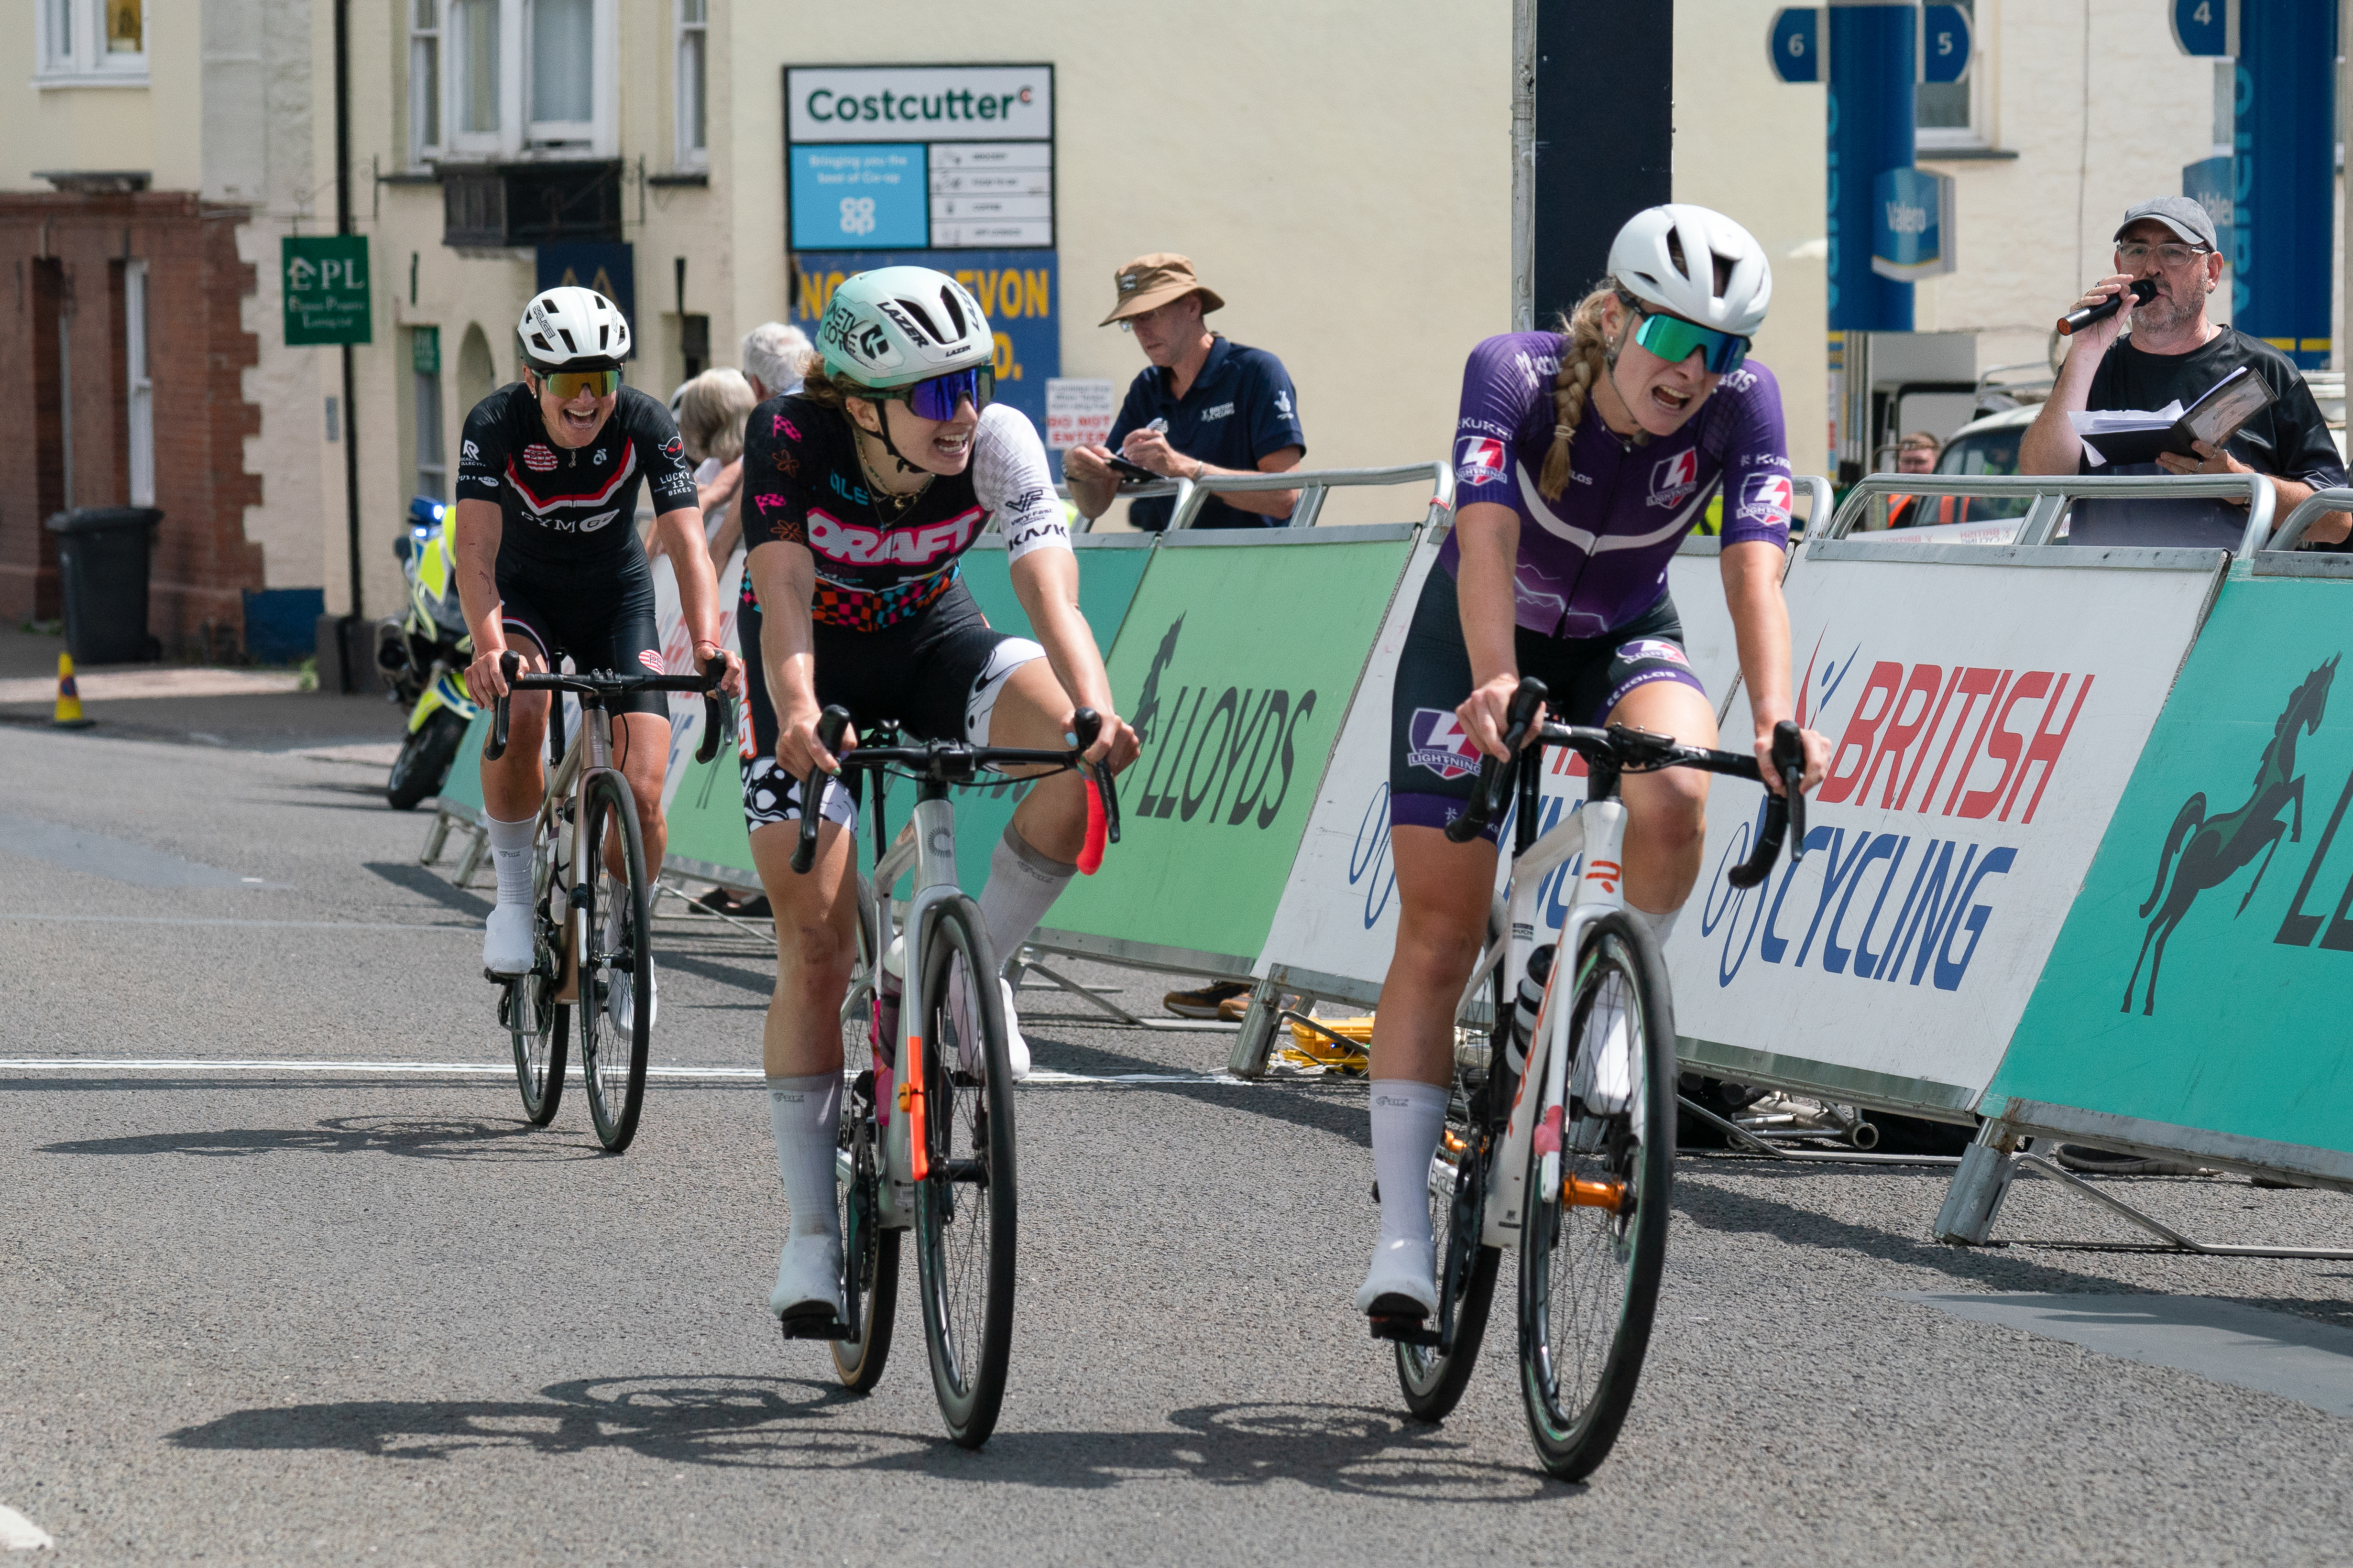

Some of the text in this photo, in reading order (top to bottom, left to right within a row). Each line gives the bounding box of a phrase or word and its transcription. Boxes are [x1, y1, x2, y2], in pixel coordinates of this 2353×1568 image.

[2193, 1, 2212, 25] 4
[1788, 33, 1805, 57] 6
[1938, 32, 1953, 54] 5
[806, 88, 1014, 121] Costcutter
[532, 305, 556, 339] SALICE
[876, 301, 930, 348] LAZER
[946, 345, 972, 358] LAZER
[1047, 415, 1110, 428] DO NOT
[660, 471, 689, 484] LUCKY
[672, 479, 684, 489] 13
[668, 487, 691, 496] BIKES
[807, 507, 985, 564] DRAFT
[1008, 524, 1066, 552] KASK
[1816, 660, 2095, 824] BRITISH
[1136, 686, 1317, 830] LLOYDS
[1411, 753, 1482, 774] LIGHTNING
[1761, 825, 2018, 992] CYCLING
